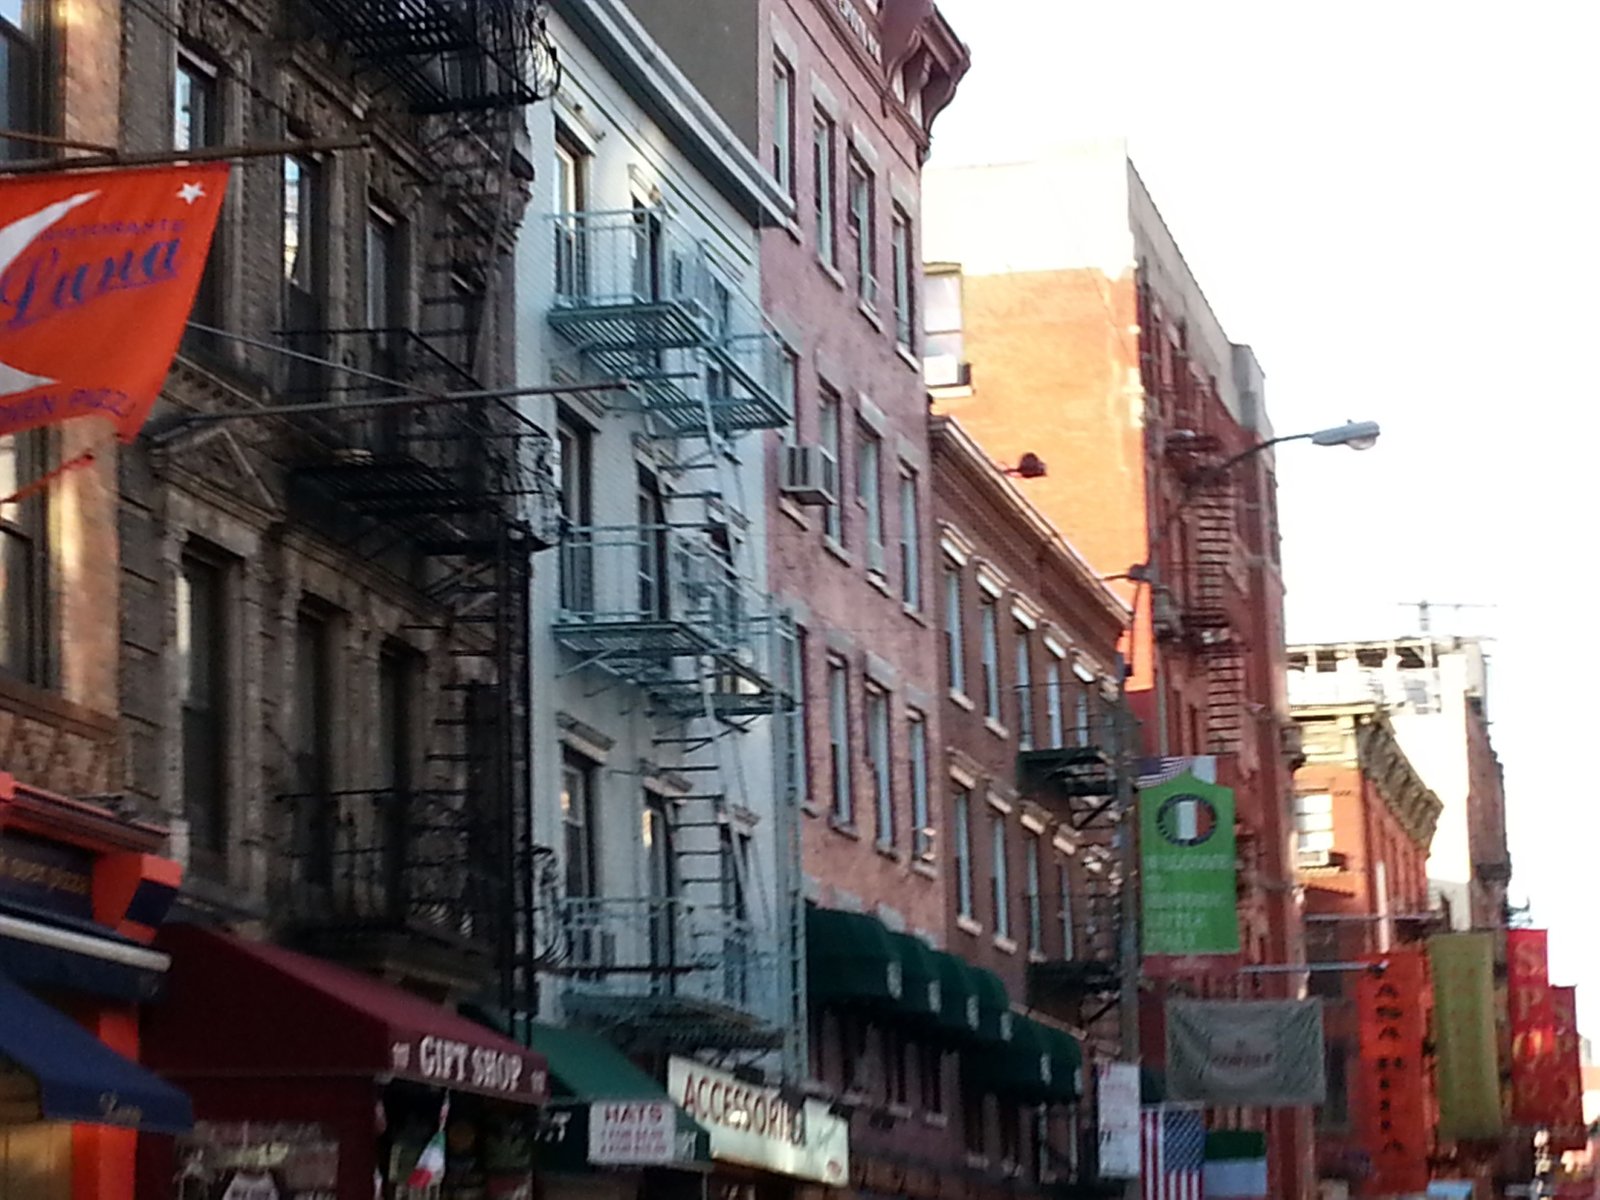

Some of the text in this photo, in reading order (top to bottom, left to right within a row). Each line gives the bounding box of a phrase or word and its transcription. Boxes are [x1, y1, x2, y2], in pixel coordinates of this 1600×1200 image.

[419, 1034, 468, 1082] GIFT
[471, 1046, 523, 1092] SHOP
[604, 1103, 663, 1124] HATS
